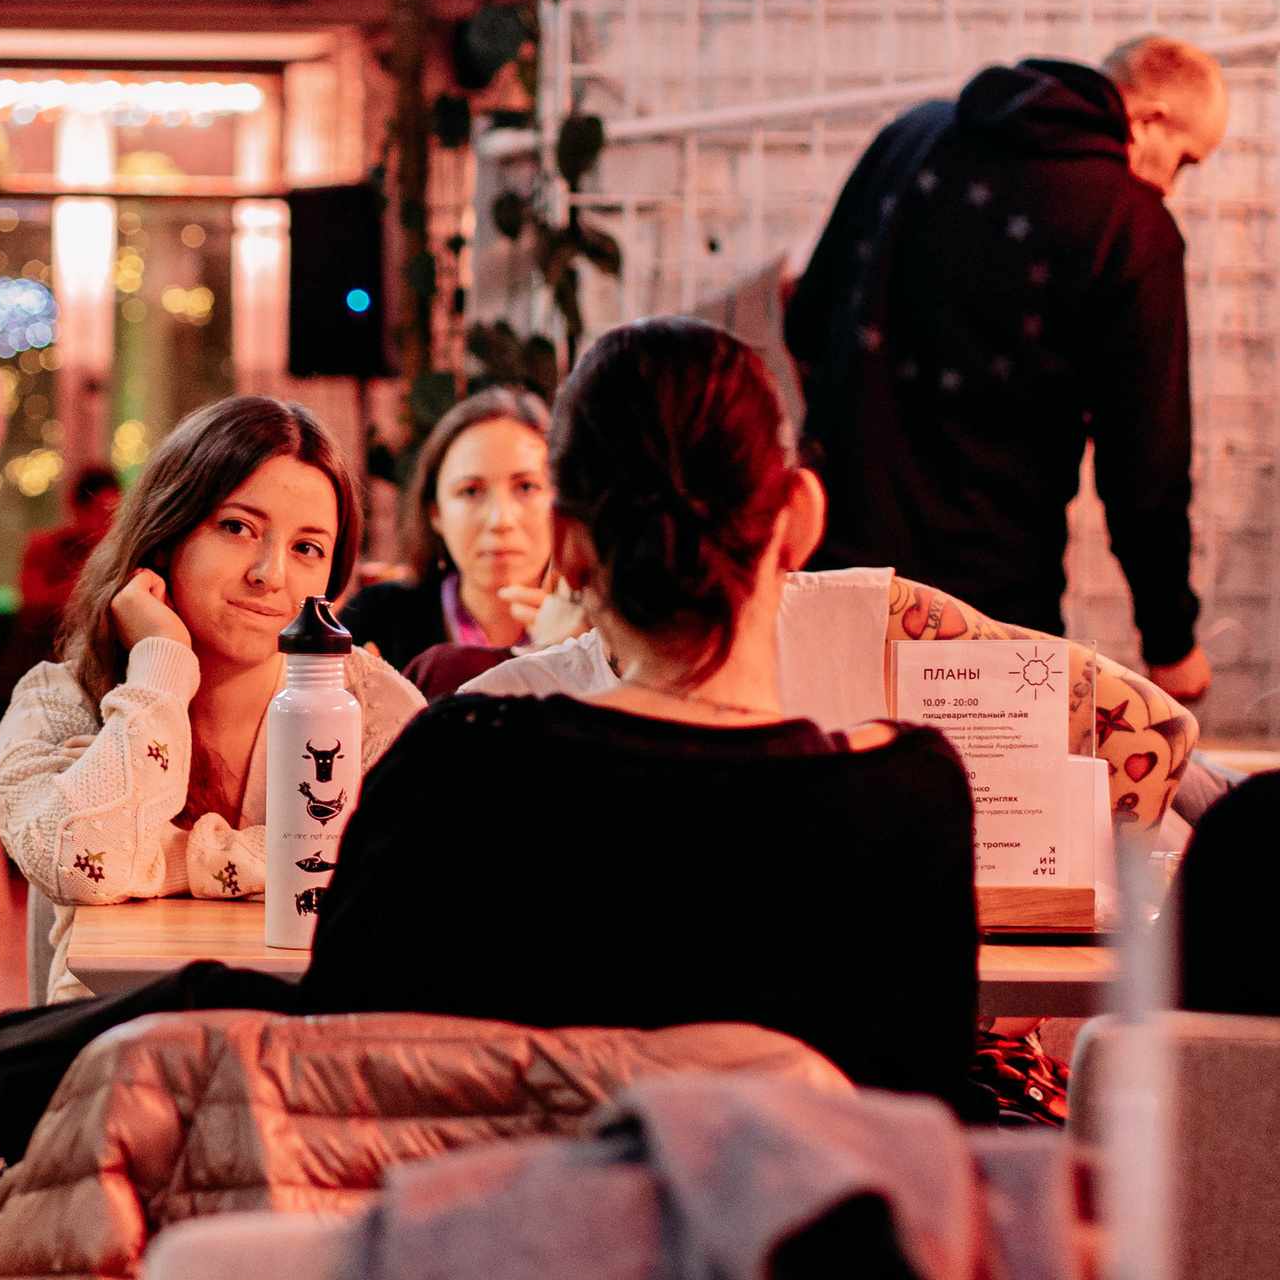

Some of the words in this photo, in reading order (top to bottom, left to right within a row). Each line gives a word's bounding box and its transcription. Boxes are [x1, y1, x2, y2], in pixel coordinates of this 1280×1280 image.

[923, 668, 980, 680] ПЛАНЫ
[923, 698, 946, 707] 10.09
[953, 698, 979, 707] 20:00
[923, 711, 1005, 719] пищеварительный
[1008, 710, 1028, 718] лайв
